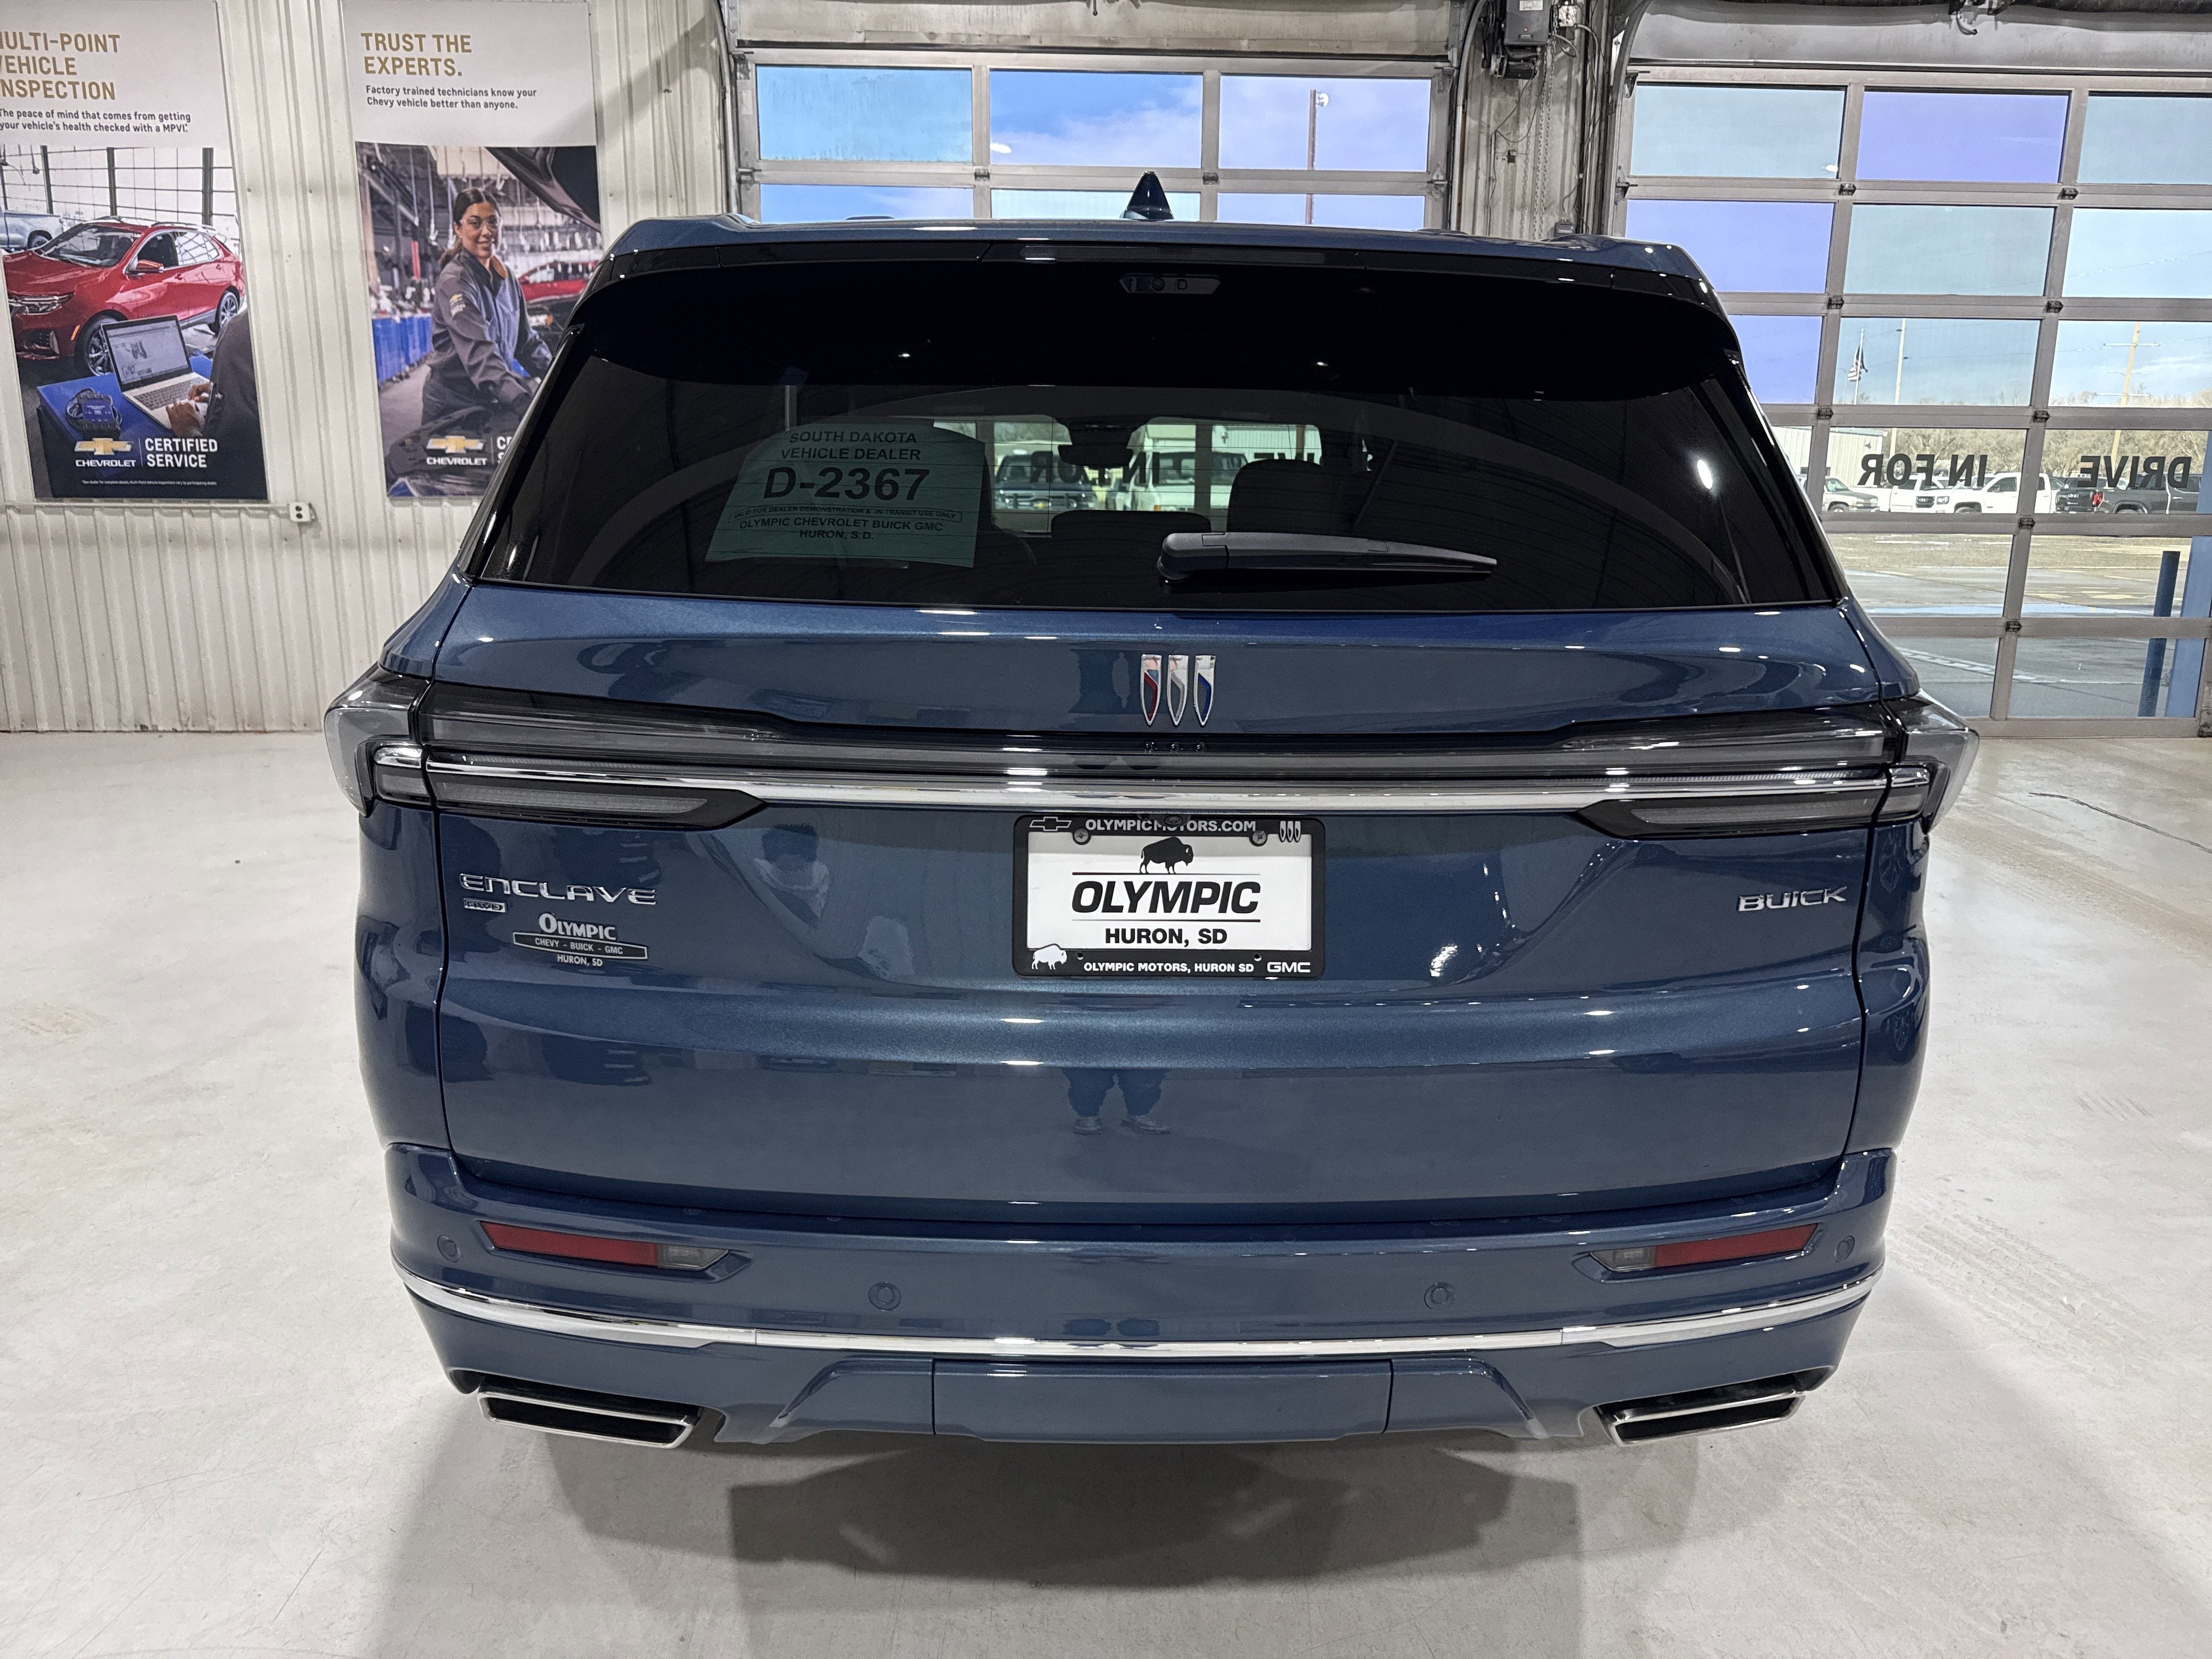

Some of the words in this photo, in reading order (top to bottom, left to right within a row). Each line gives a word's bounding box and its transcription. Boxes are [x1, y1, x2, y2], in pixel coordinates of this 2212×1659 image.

[361, 32, 426, 52] TRUST
[432, 34, 472, 53] THE
[0, 55, 77, 75] EHICLE
[364, 57, 462, 77] EXPERTS.
[0, 78, 115, 100] NSPECTION
[366, 85, 400, 97] Factory
[403, 87, 435, 95] trained
[437, 87, 489, 97] technicians
[491, 88, 515, 97] know
[517, 90, 537, 99] your
[367, 97, 394, 108] Chevy
[397, 98, 428, 107] vehicle
[431, 99, 459, 108] better
[461, 99, 481, 109] than
[484, 101, 518, 110] anyone.
[17, 110, 43, 120] peace
[46, 110, 54, 118] of
[57, 110, 79, 119] mind
[82, 110, 101, 119] that
[103, 112, 132, 120] comes
[134, 111, 156, 120] from
[159, 112, 191, 123] getting
[0, 122, 19, 131] your
[22, 121, 60, 130] vehicle's
[63, 122, 92, 131] health
[94, 123, 130, 132] checked
[133, 123, 153, 132] with
[789, 431, 844, 443] SOUTH
[850, 431, 917, 443] DAKOTA
[145, 437, 218, 453] CERTIFIED
[146, 454, 207, 468] SERVICE
[426, 456, 487, 466] CHEVROLET
[781, 448, 849, 460] VEHICLE
[854, 448, 921, 460] DEALER
[75, 459, 137, 467] CHEVROLET
[763, 466, 930, 501] D-2367
[800, 506, 865, 514] DEMONSTRATION
[935, 511, 956, 519] ONLY
[740, 517, 790, 529] OLYMPIC
[794, 517, 870, 527] CHEVROLET
[872, 520, 911, 530] BUICK
[915, 521, 944, 531] GMC
[799, 529, 847, 540] HURON,
[851, 531, 874, 540] S.D.
[1071, 881, 1261, 913] OLYMPIC
[1737, 886, 1847, 912] BUICK
[465, 899, 504, 911] AWD
[1105, 928, 1189, 947] HURON,
[1198, 928, 1228, 944] SD
[535, 937, 559, 949] CHEVY
[570, 941, 594, 952] BUICK
[605, 945, 623, 956] GMC
[557, 953, 590, 967] HURON,
[592, 957, 603, 967] SD
[1267, 961, 1311, 973] GMC
[1084, 961, 1134, 973] OLYMPIC
[1138, 962, 1190, 974] MOTORS,
[1194, 962, 1235, 973] HURON
[1238, 963, 1255, 973] SD
